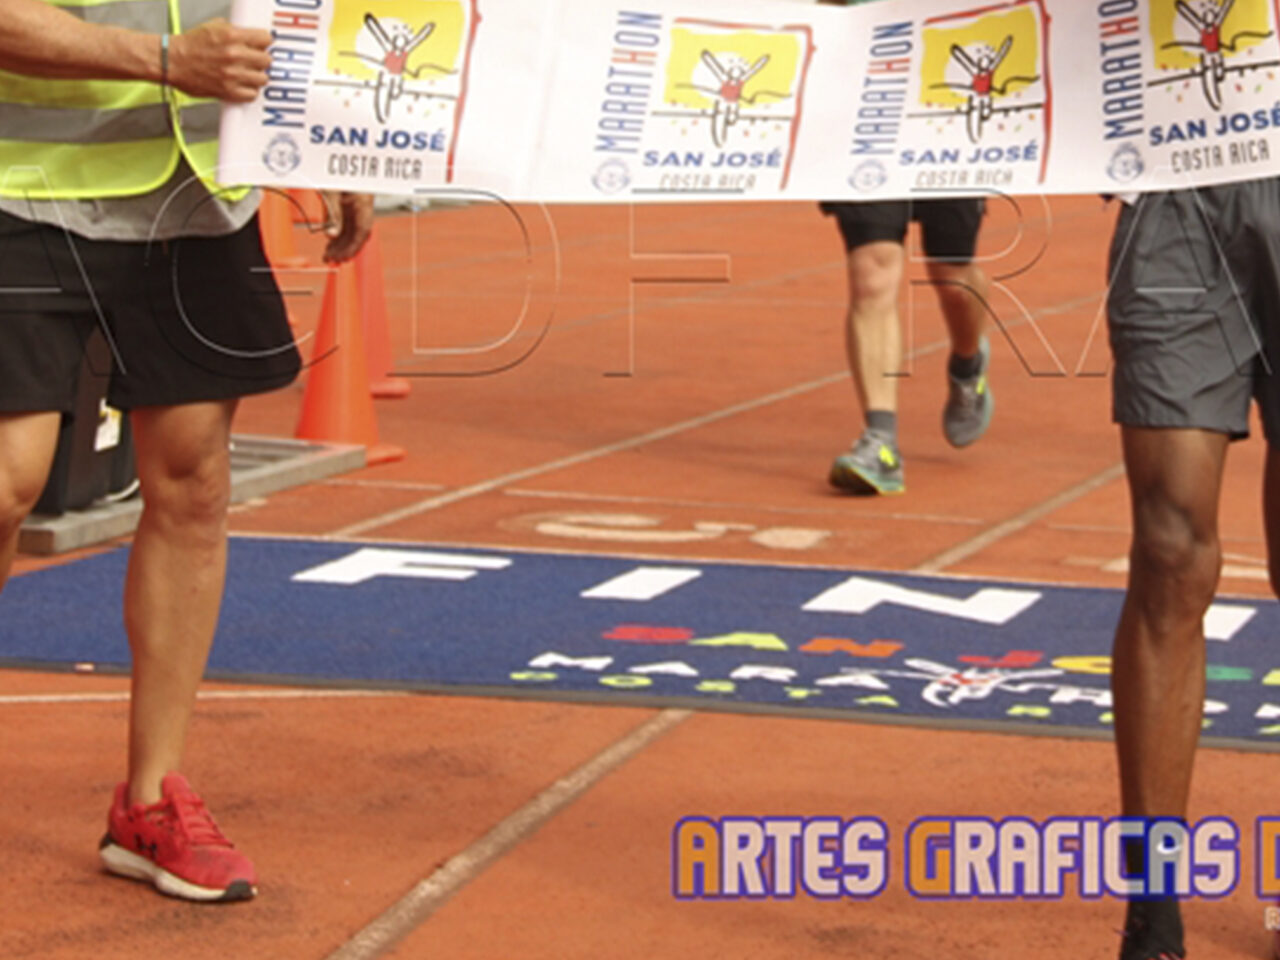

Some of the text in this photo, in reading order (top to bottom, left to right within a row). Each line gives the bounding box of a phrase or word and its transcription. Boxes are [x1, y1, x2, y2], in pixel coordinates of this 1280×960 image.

[594, 10, 663, 154] MARATHON
[850, 21, 913, 155] MARATHON
[310, 125, 446, 152] SAN JOSÉ
[1149, 118, 1207, 146] SAN
[327, 153, 422, 180] COSTA RICA
[643, 147, 782, 167] SAN JOSÉ
[899, 140, 1038, 166] SAN JOSÉ
[1171, 139, 1271, 173] COSTA RICA
[915, 169, 1013, 187] COSTA RICA
